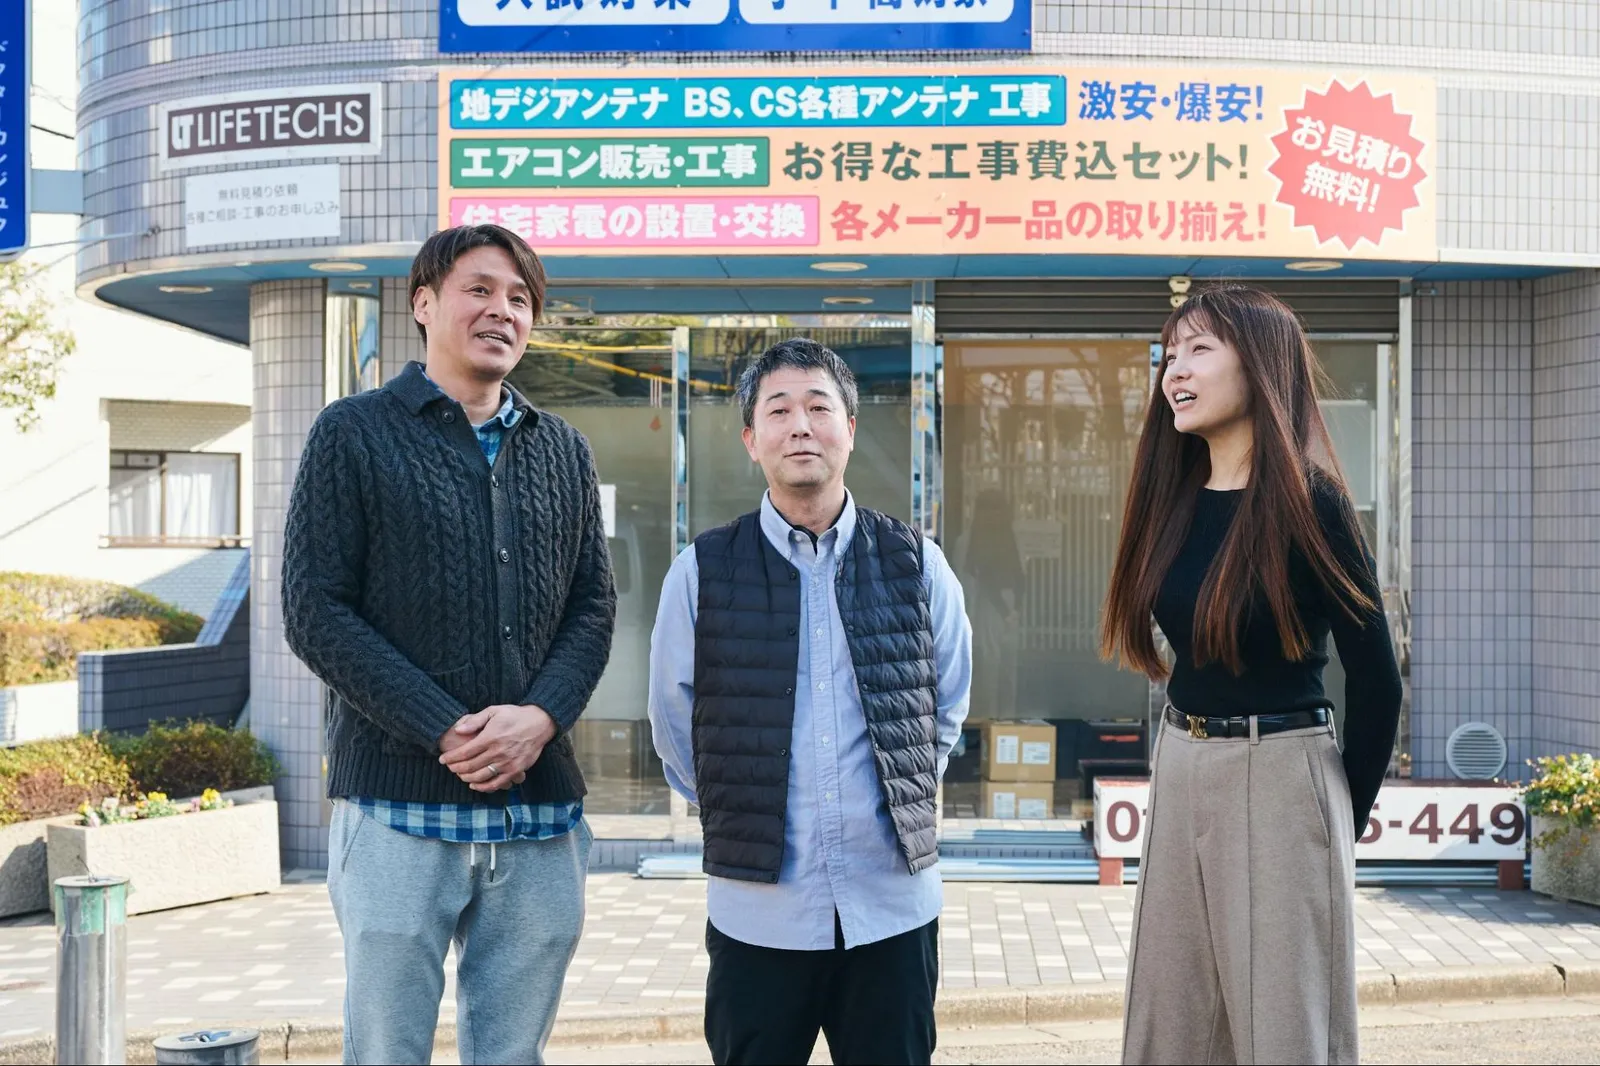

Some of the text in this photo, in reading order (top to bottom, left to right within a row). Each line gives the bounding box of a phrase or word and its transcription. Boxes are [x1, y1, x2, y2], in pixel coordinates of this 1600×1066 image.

[460, 82, 1051, 121] 地デジアンテナ BS、CS各種アンテナ 工事
[197, 100, 364, 147] LIFETECHS
[461, 144, 757, 180] エアコン販売・工事
[783, 140, 1249, 182] お得な工事費込セット!
[1291, 116, 1412, 179] お見積り
[218, 183, 298, 200] 無料見積り依頼
[1301, 161, 1380, 213] 無料!
[831, 200, 1266, 242] 各メーカー品の取り揃え!
